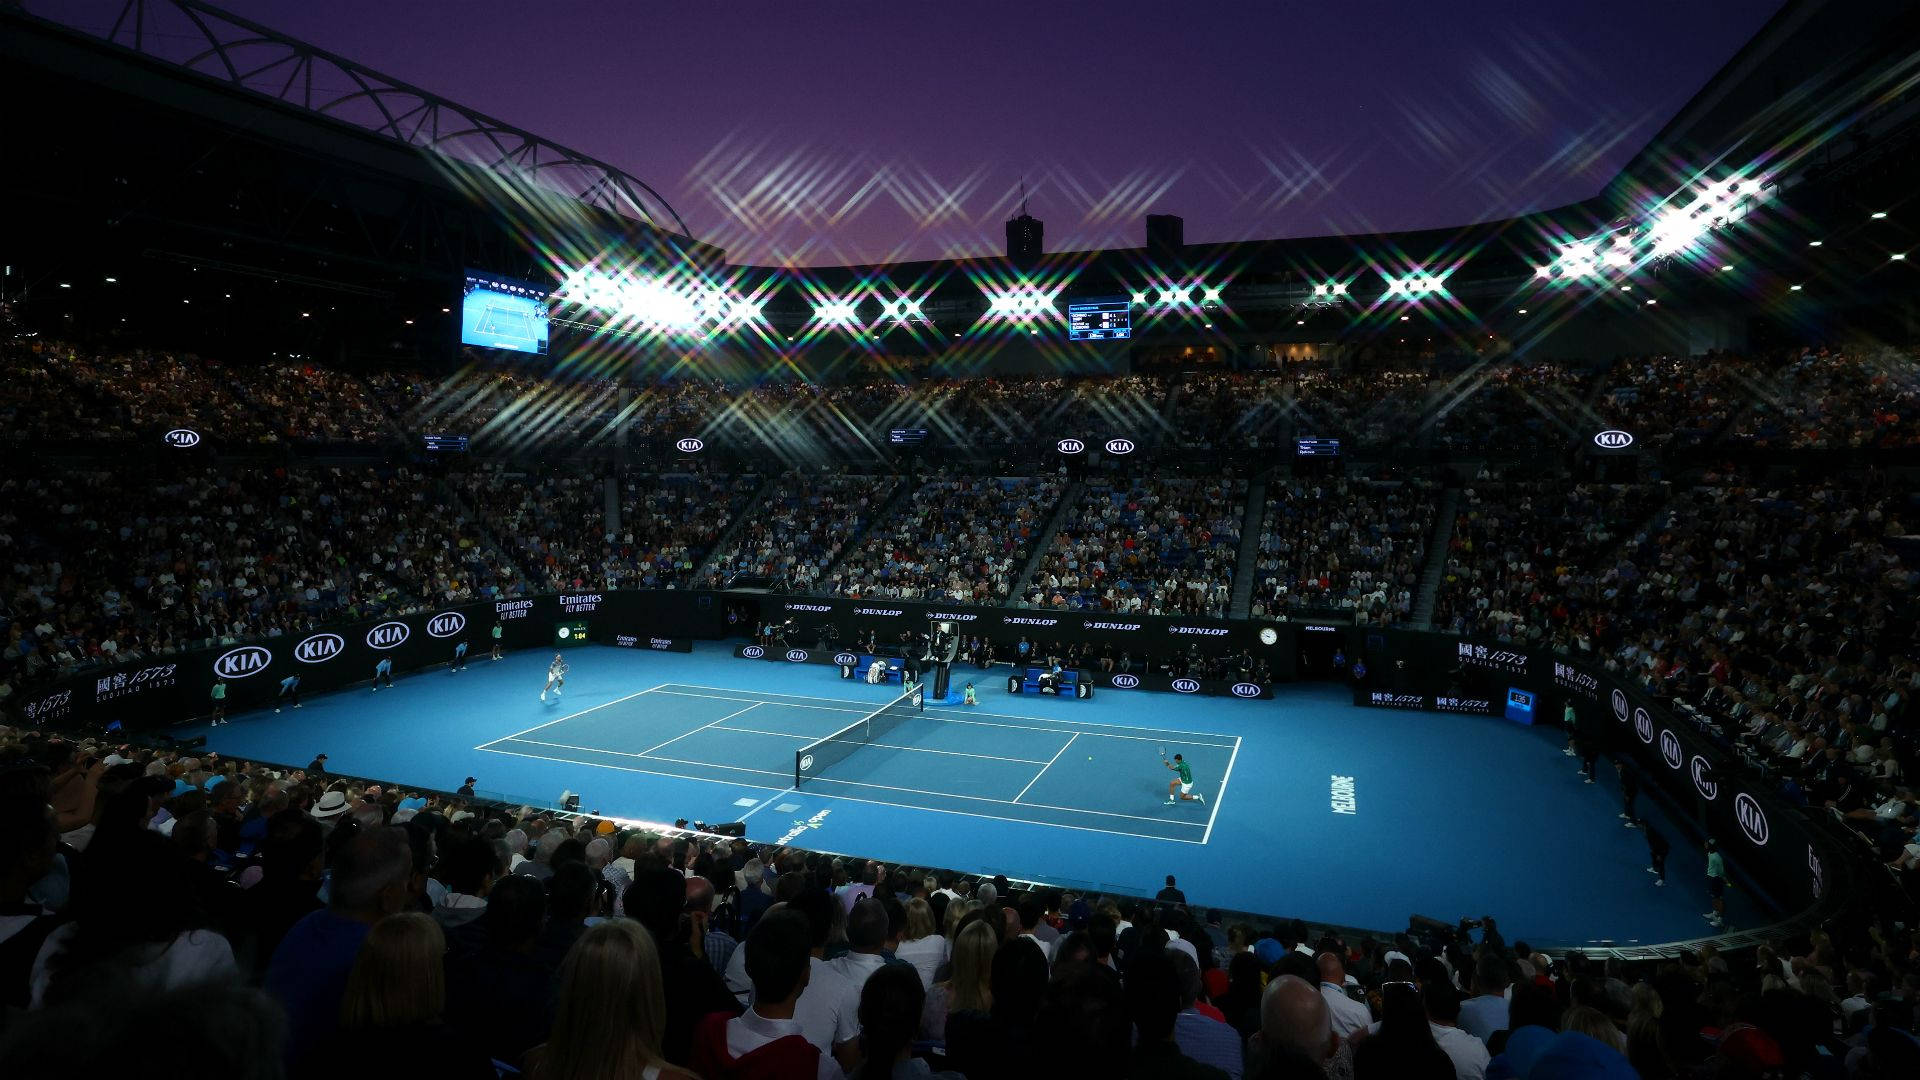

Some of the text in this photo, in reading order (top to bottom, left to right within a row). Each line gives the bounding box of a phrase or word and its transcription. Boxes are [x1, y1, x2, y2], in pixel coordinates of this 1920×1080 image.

[1601, 434, 1627, 444] KIA
[681, 441, 698, 449] KIA
[1061, 442, 1080, 450] KIA
[1110, 442, 1130, 450] KIA
[560, 594, 602, 604] Emirates
[496, 600, 533, 612] Emirates
[565, 603, 595, 613] FLY BETTER
[792, 604, 832, 612] DUNLOP
[509, 609, 527, 619] BETTER
[861, 608, 903, 617] DUNLOP
[934, 612, 978, 621] DUNLOP
[434, 616, 459, 634] KIA
[1012, 617, 1058, 626] DUNLOP
[1092, 622, 1141, 631] DUNLOP
[374, 627, 403, 645] KIA
[1177, 626, 1229, 636] DUNLOP
[303, 638, 336, 658] KIA
[746, 648, 760, 656] KIA
[789, 652, 804, 660] KIA
[838, 655, 853, 663] KIA
[224, 652, 262, 673] KIA
[1116, 677, 1134, 686] KIA
[1176, 681, 1195, 691] KIA
[1236, 686, 1256, 695] KIA
[1614, 694, 1625, 716] KIA
[1637, 711, 1650, 739] KIA
[1663, 734, 1678, 764] KIA
[1740, 799, 1763, 839] KIA
